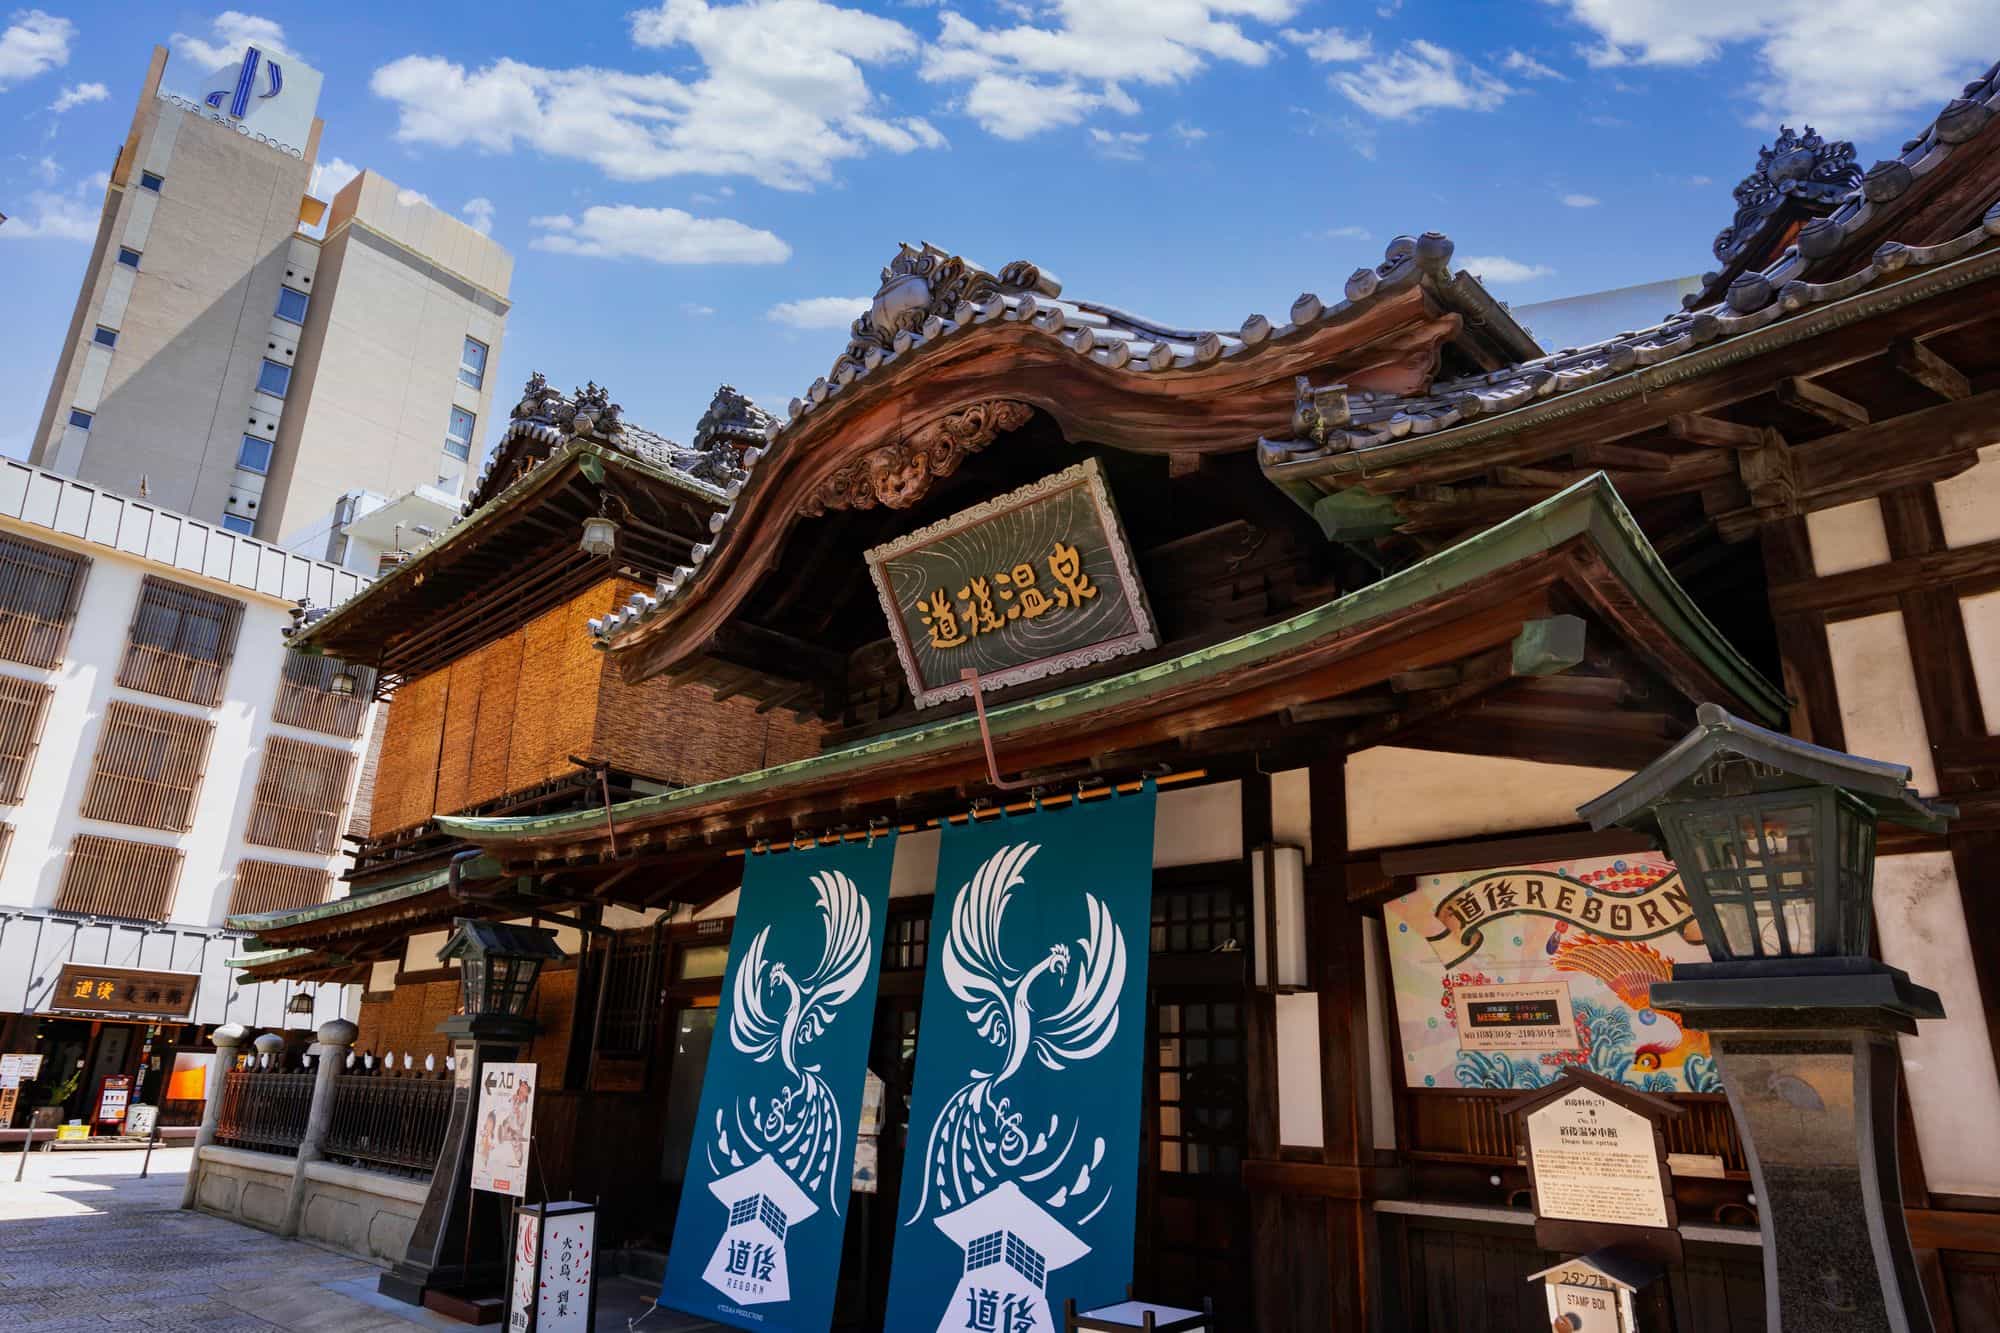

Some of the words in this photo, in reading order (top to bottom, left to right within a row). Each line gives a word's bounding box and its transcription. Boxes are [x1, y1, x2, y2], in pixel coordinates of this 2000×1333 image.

[916, 542, 1098, 649] 道後温泉
[499, 1071, 514, 1089] 入口
[725, 1240, 777, 1282] 道後
[965, 1287, 1038, 1333] 道後
[1567, 1294, 1590, 1307] STAMP
[1592, 1298, 1606, 1310] BOX
